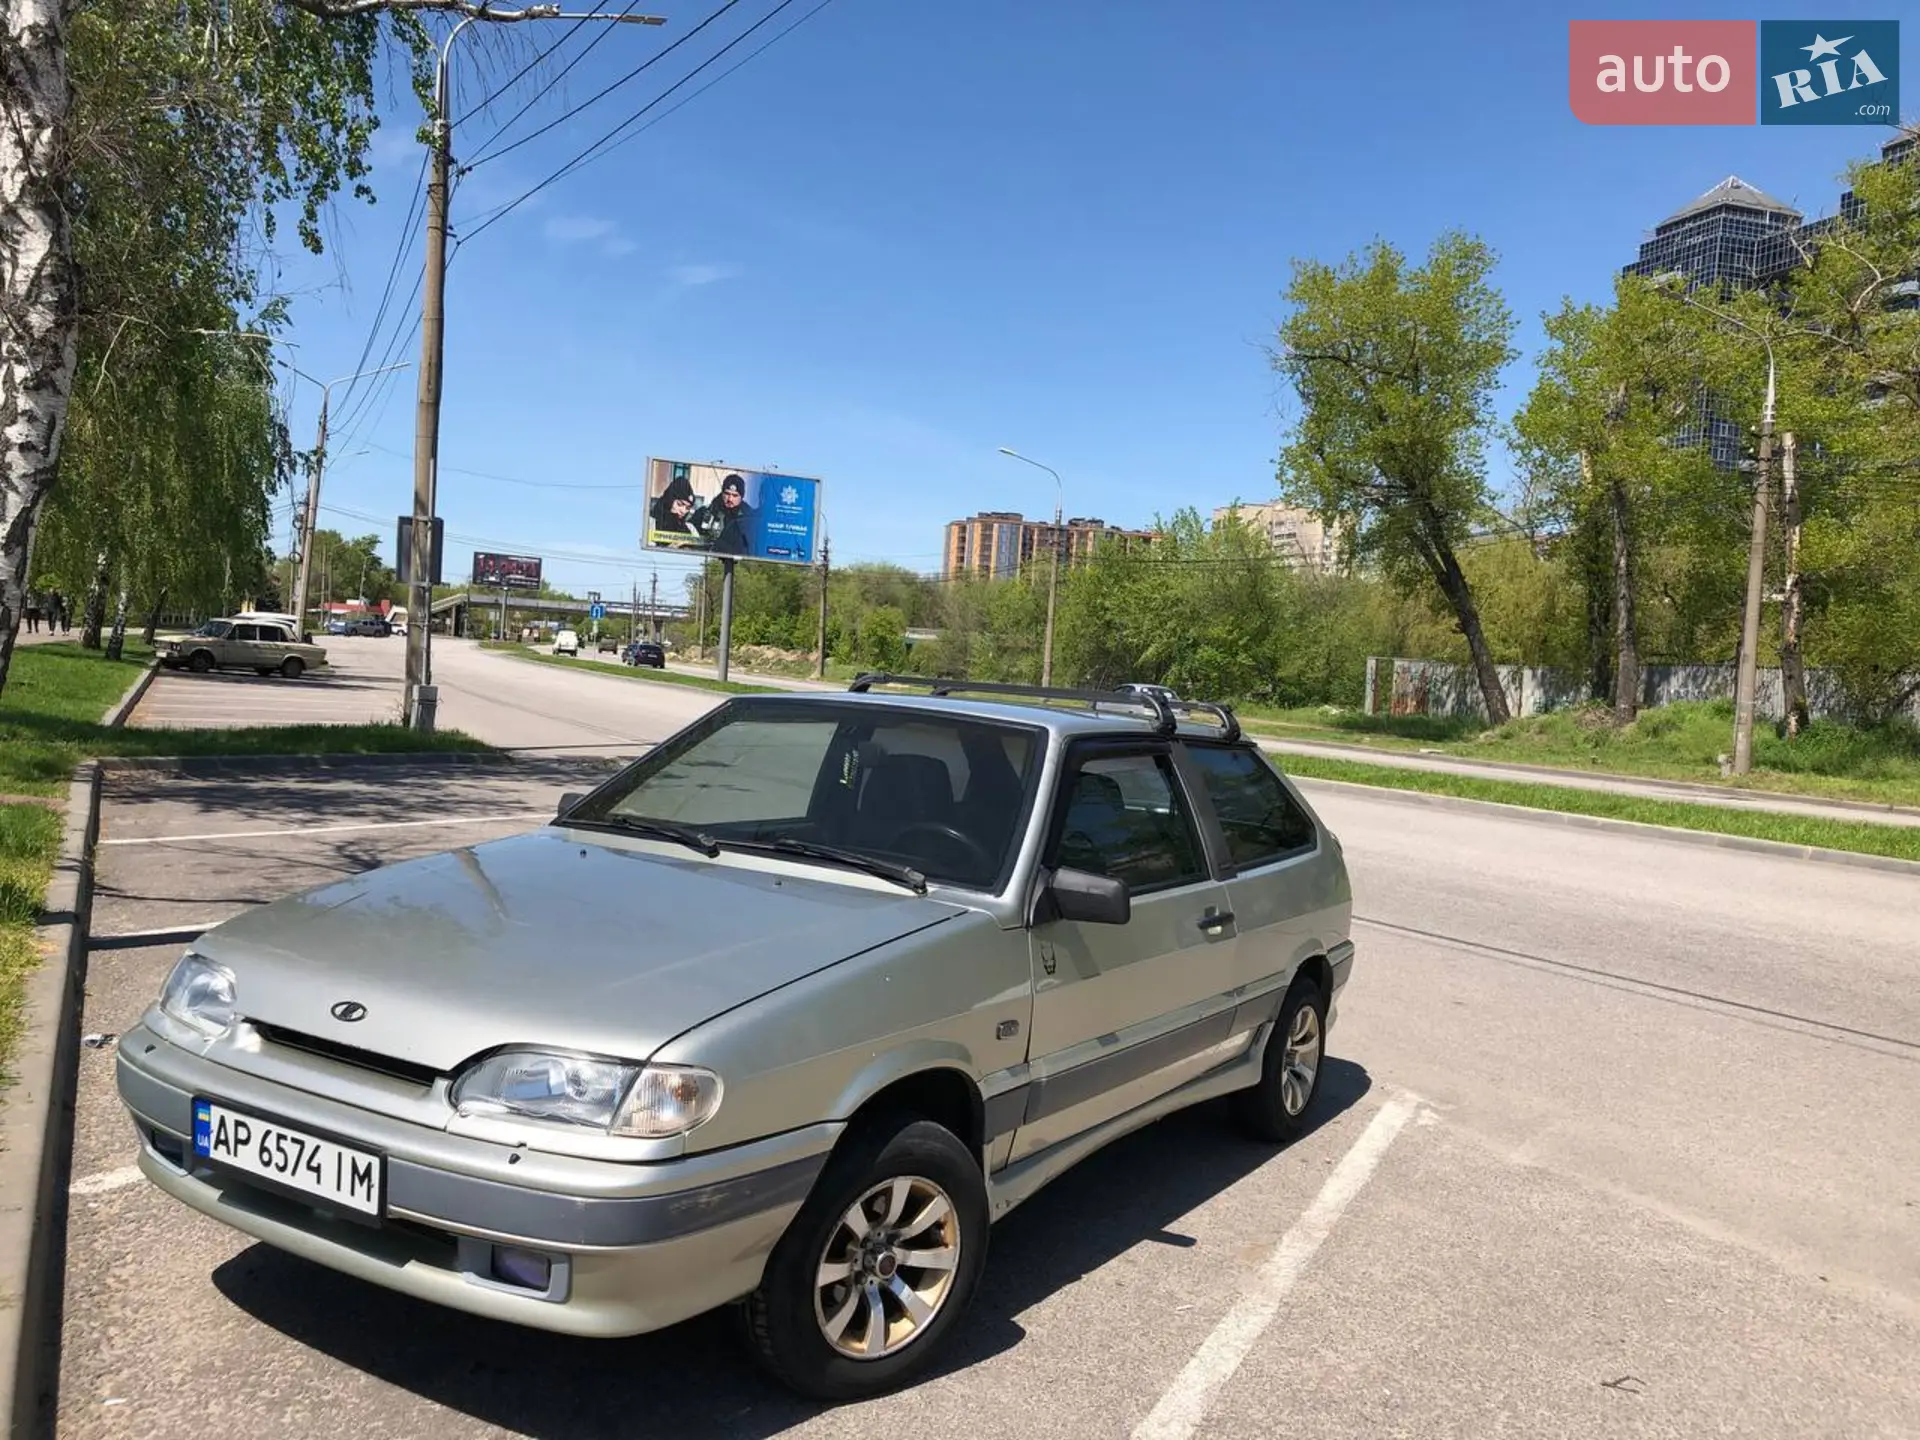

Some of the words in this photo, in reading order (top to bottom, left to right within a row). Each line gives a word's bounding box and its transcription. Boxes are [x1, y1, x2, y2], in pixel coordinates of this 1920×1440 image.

[197, 1134, 209, 1148] UA
[213, 1114, 251, 1157] AP
[259, 1129, 322, 1185] 6574
[336, 1151, 373, 1202] IM
